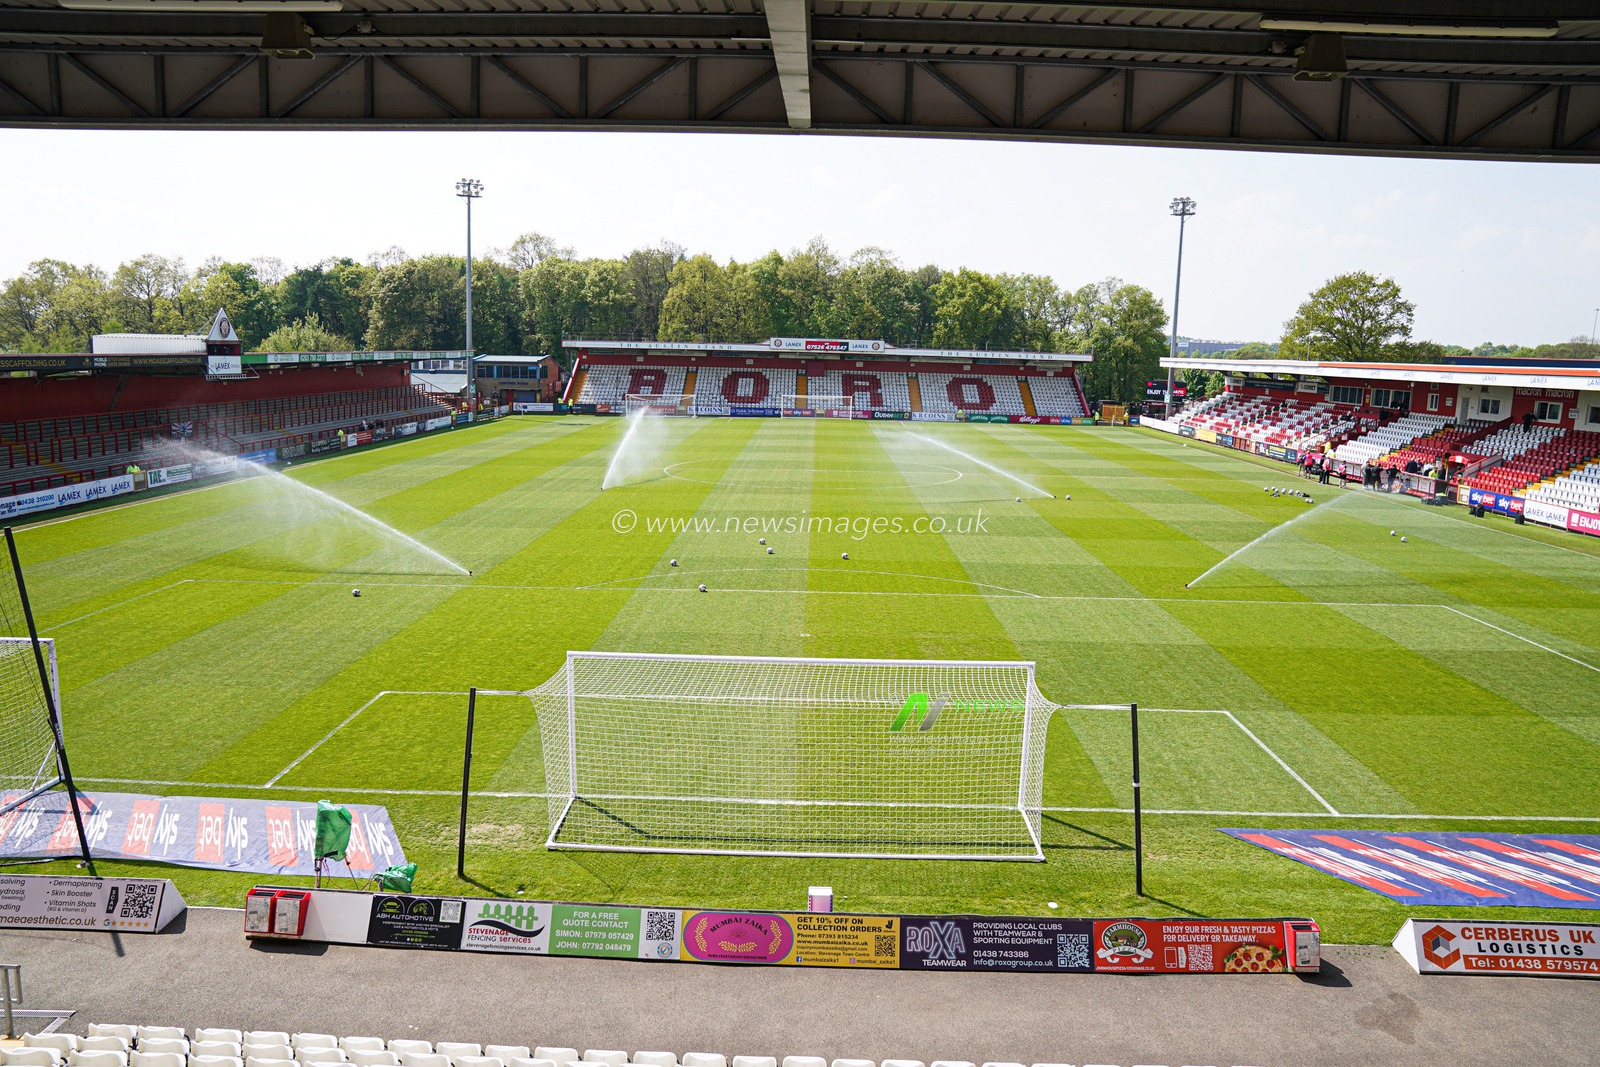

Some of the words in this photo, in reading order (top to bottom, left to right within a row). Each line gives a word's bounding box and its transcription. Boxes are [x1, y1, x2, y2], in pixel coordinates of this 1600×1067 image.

[214, 362, 230, 370] LAMEX
[1516, 388, 1542, 396] macron
[1546, 389, 1574, 398] macron
[58, 490, 81, 502] LAMEX
[86, 486, 106, 496] LAMEX
[111, 480, 130, 492] LAMEX
[1472, 492, 1482, 503] sky
[1483, 495, 1494, 504] bet
[1498, 498, 1510, 510] sky
[1510, 500, 1522, 511] bet
[1525, 505, 1544, 516] LAMEX
[1546, 511, 1566, 523] LAMEX
[128, 812, 154, 852] bet
[154, 804, 180, 856] sky
[199, 815, 222, 856] bet
[225, 807, 248, 860] sky
[268, 818, 295, 860] bet
[364, 813, 394, 866] sky
[0, 878, 25, 886] solving
[53, 880, 102, 890] Dermaplaning
[107, 889, 116, 911] SCAN
[573, 911, 589, 919] FOR
[562, 919, 589, 927] QUOTE
[592, 920, 629, 929] CONTACT
[710, 917, 742, 933] MUMBAI
[744, 918, 768, 935] ZAIKA
[1106, 924, 1142, 937] FARMHOUSE
[1163, 926, 1184, 934] ENJOY
[468, 928, 509, 936] STEVENAGE
[555, 930, 582, 938] SIMON:
[608, 932, 634, 940] 057429
[1461, 927, 1560, 943] CERBERUS
[1569, 930, 1596, 944] UK
[499, 935, 532, 944] services
[556, 941, 580, 949] JOHN:
[582, 942, 603, 950] 07792
[605, 943, 631, 951] 048479
[906, 921, 966, 959] ROXA
[466, 943, 541, 952] stevenagefencingservices.co.uk
[1478, 942, 1584, 956] LOGISTICS
[974, 958, 1053, 968] info@roxagroup.co.uk
[1468, 957, 1494, 968] Tel:
[1499, 958, 1542, 969] 01438
[1546, 960, 1598, 971] 579574
